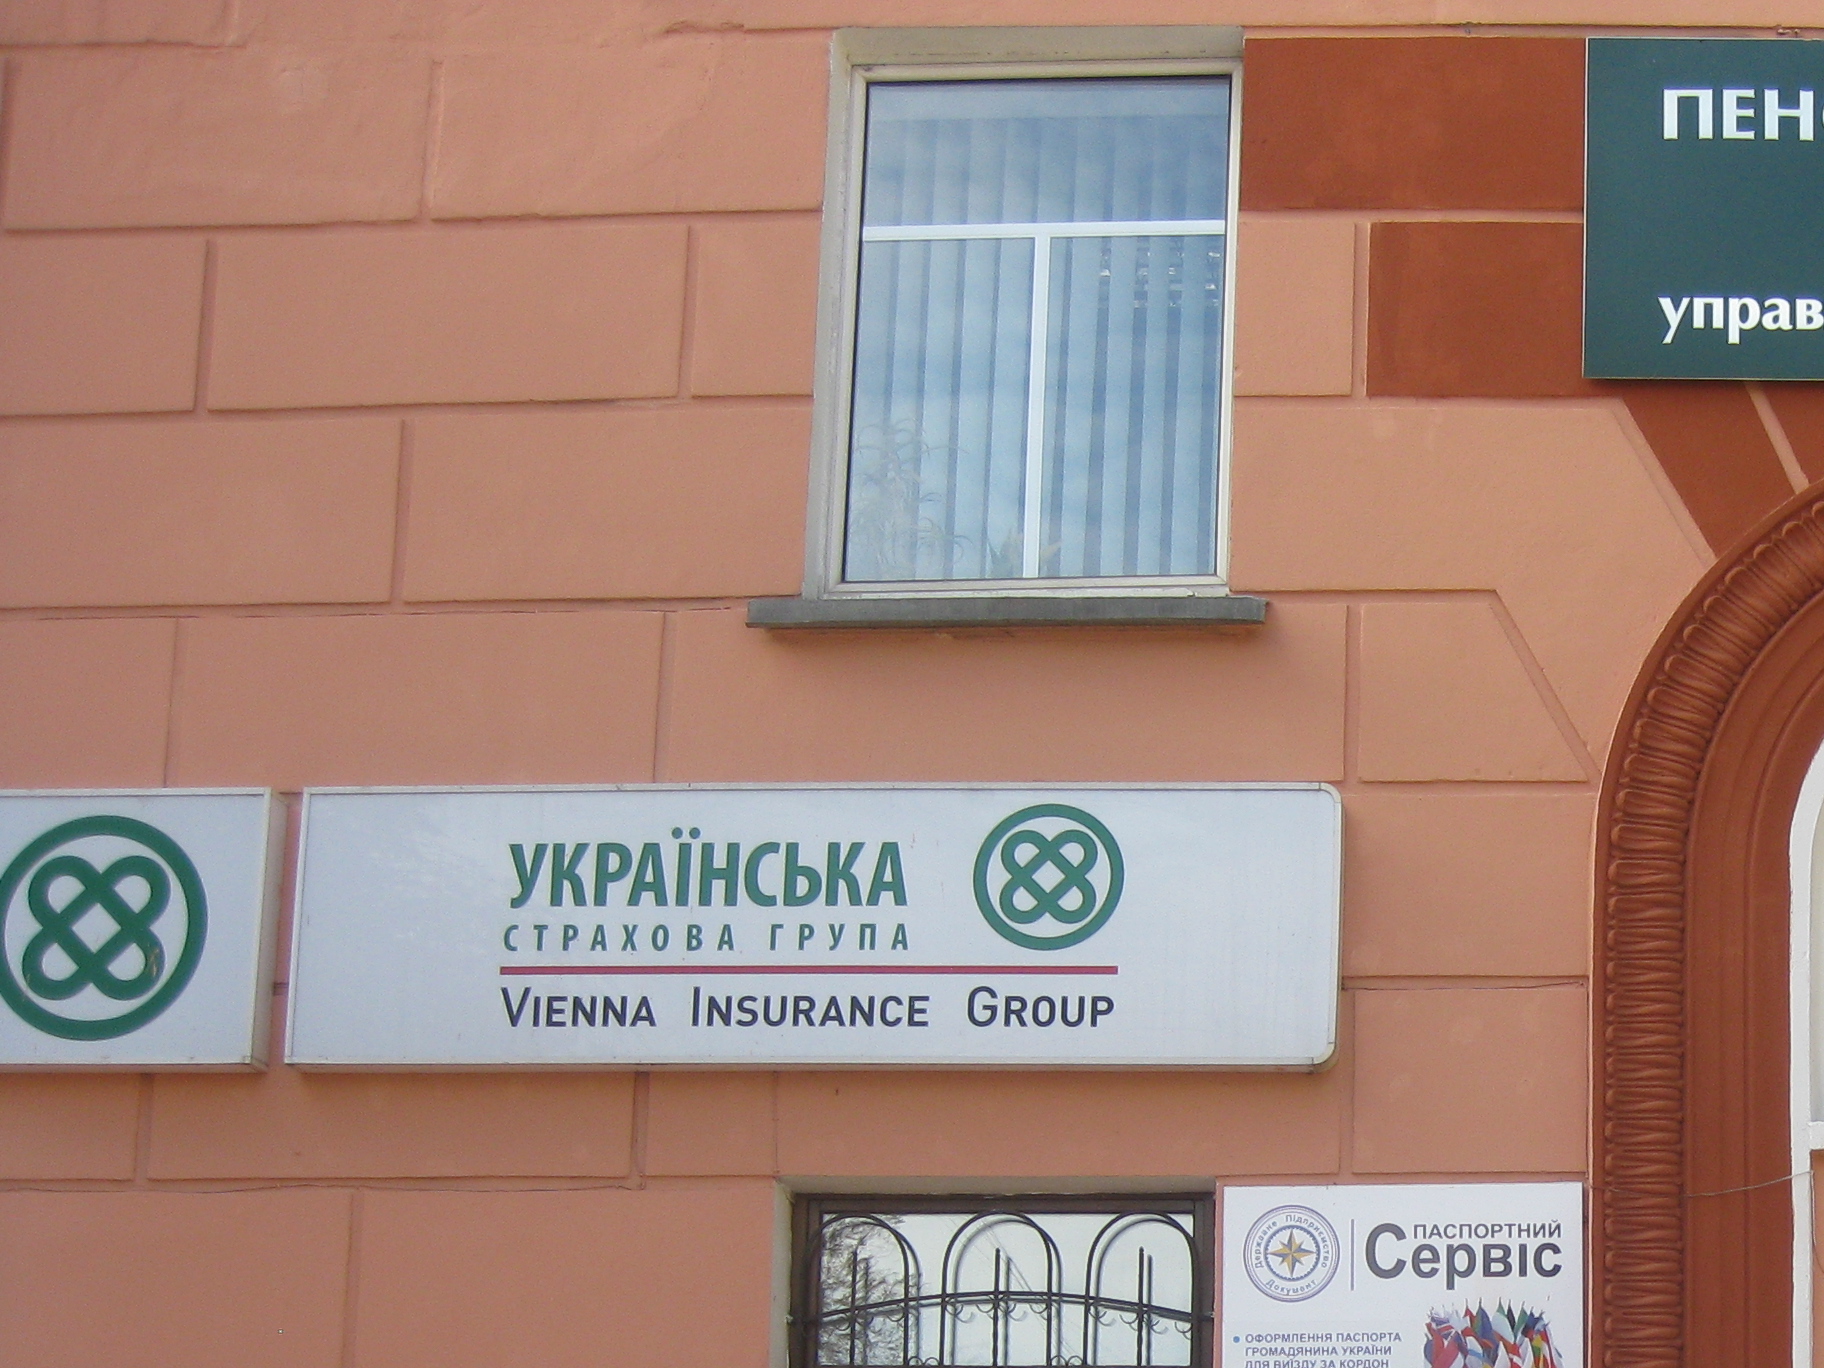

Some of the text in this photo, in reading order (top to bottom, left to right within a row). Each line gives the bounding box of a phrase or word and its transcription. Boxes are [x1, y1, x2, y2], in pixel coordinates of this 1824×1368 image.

[510, 827, 907, 908] УКРАЇНСЬКА
[503, 923, 910, 952] СТРАХОВА ГРУПА
[1413, 1219, 1562, 1239] ПАСПОРТНИЙ
[1365, 1222, 1562, 1290] Сервіс
[1246, 1332, 1402, 1344] ОФОРМЛЕННЯ ПАСПОРТА
[1246, 1344, 1391, 1358] ГРОМАДЯНИНА УКРАЇНИ
[1321, 1359, 1336, 1368] ЗА
